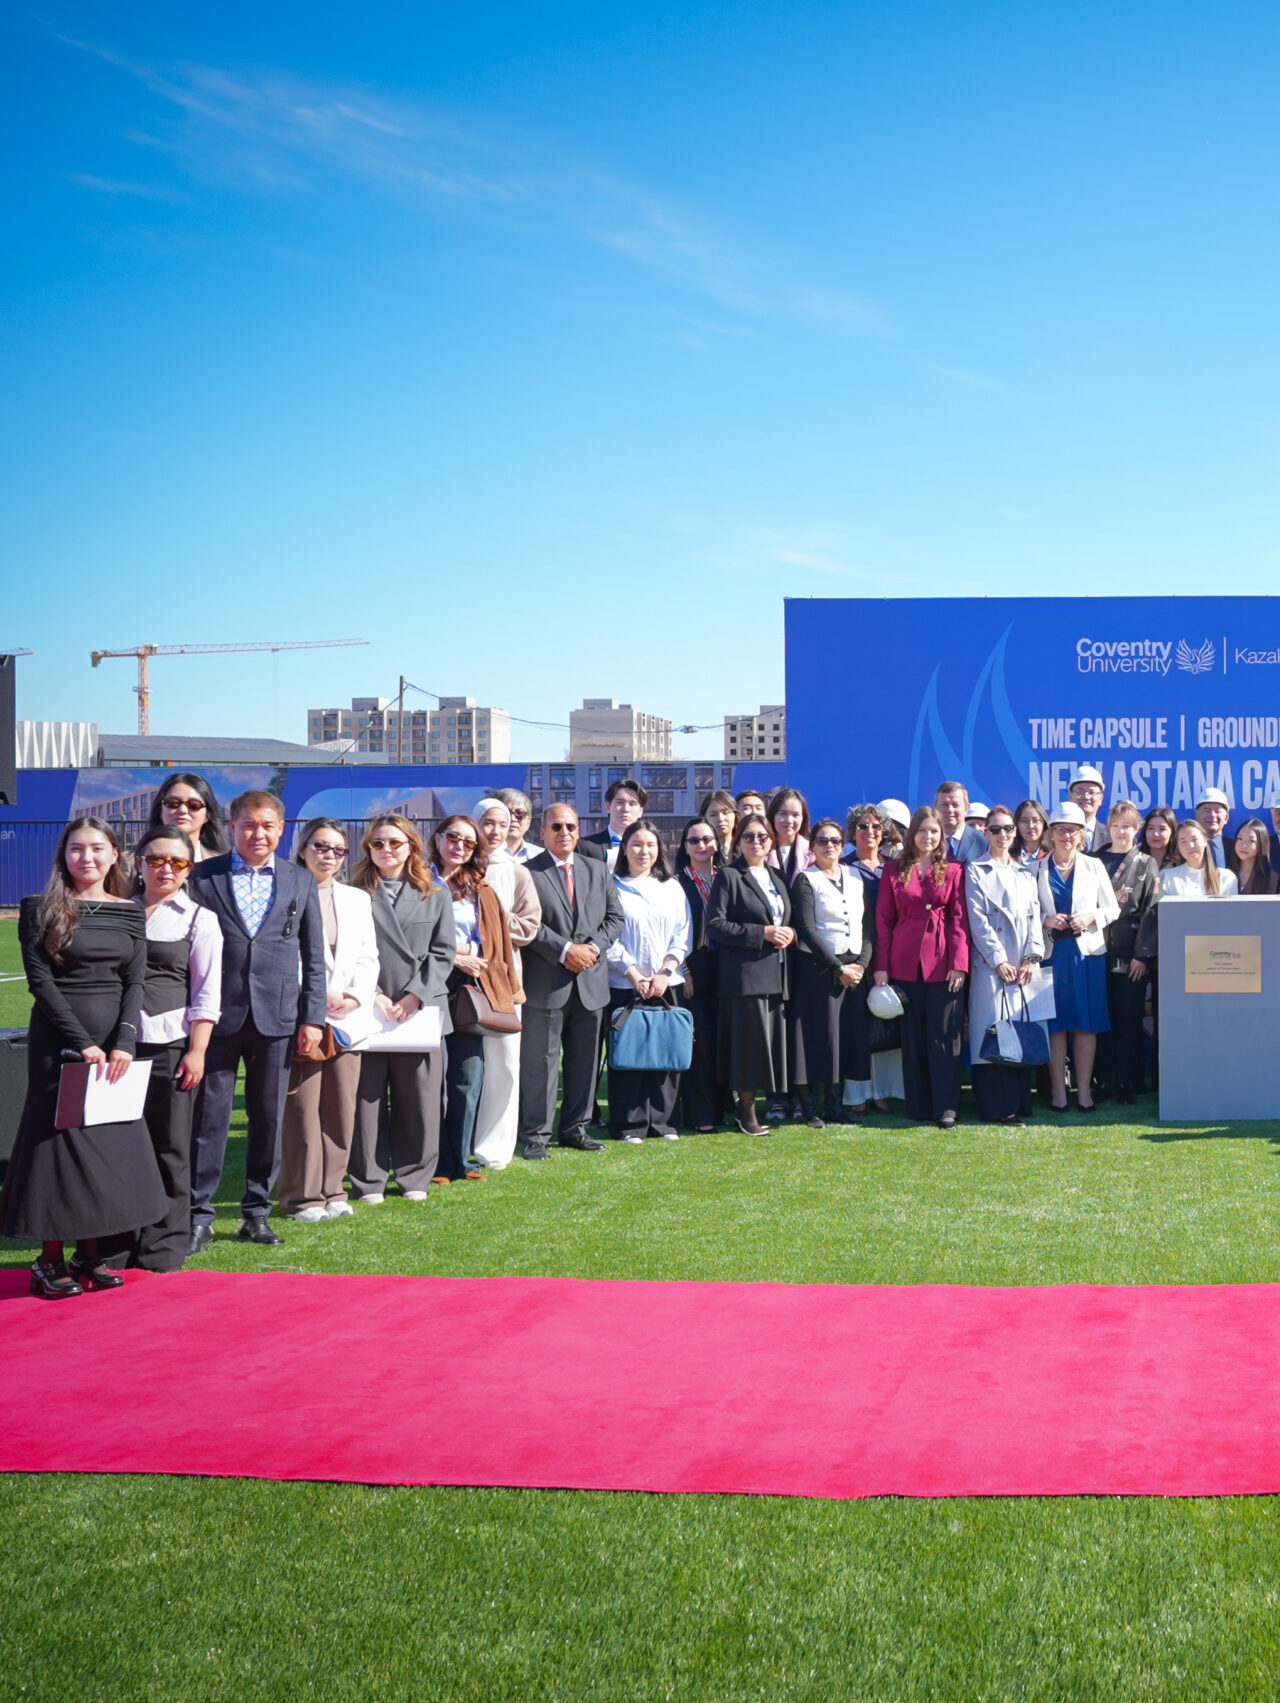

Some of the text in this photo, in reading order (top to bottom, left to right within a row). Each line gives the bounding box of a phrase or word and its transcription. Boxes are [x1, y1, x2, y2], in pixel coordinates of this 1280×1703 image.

[1076, 637, 1173, 661] Coventry
[1077, 655, 1173, 677] University
[1028, 718, 1076, 749] TIME
[1079, 717, 1168, 749] CAPSULE
[1109, 760, 1236, 810] ASTANA
